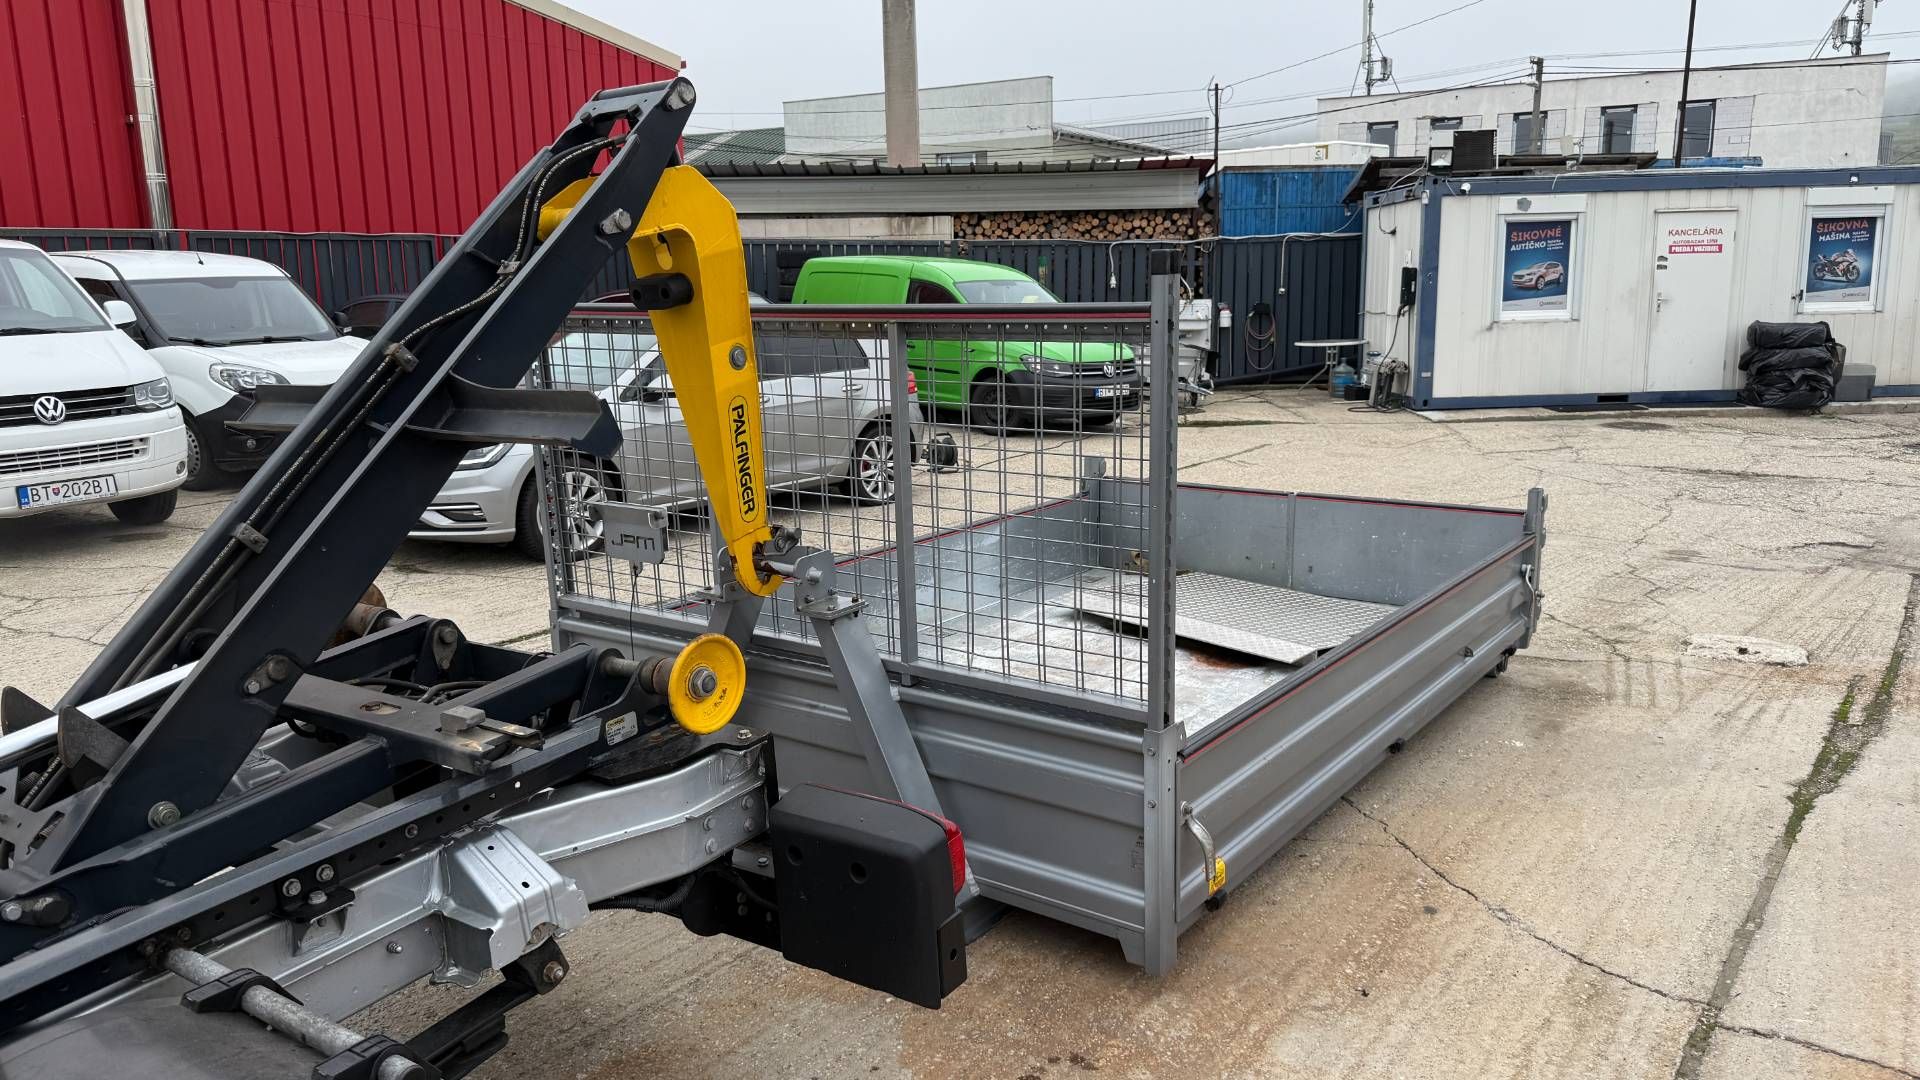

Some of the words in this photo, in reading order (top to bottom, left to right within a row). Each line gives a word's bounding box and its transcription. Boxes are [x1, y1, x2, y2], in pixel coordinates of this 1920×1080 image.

[1510, 225, 1562, 241] ŠIKOVNÉ
[1668, 226, 1723, 237] KANCELÁRIA
[1818, 231, 1851, 242] MAŠINA
[1510, 240, 1546, 251] AUTÍČKO
[731, 403, 756, 516] PALFINGER
